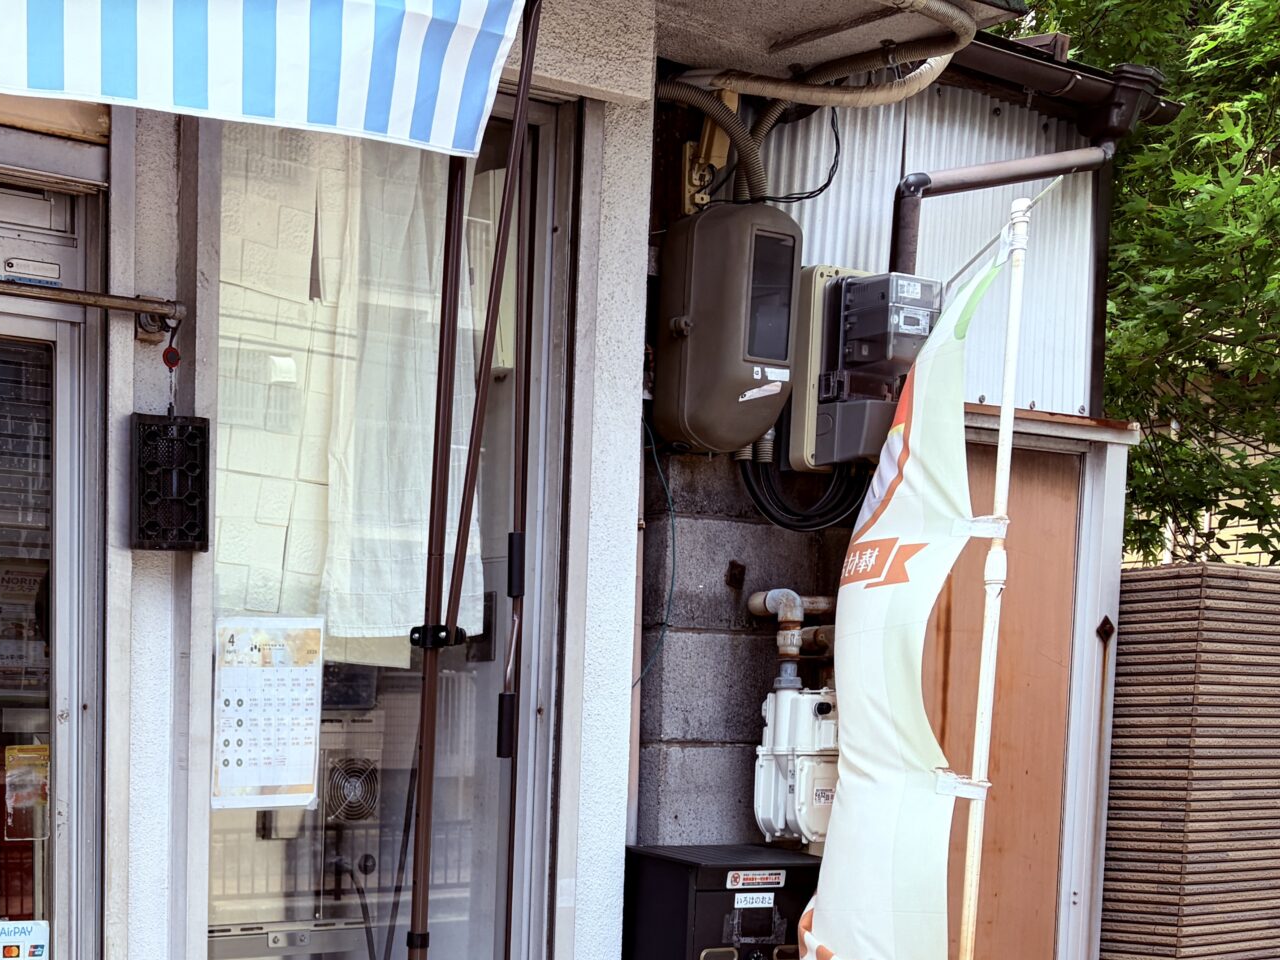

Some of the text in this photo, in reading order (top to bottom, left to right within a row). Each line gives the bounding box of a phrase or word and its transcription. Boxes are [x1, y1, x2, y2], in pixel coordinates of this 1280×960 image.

[228, 634, 235, 646] 4
[737, 896, 772, 905] いろはのおと
